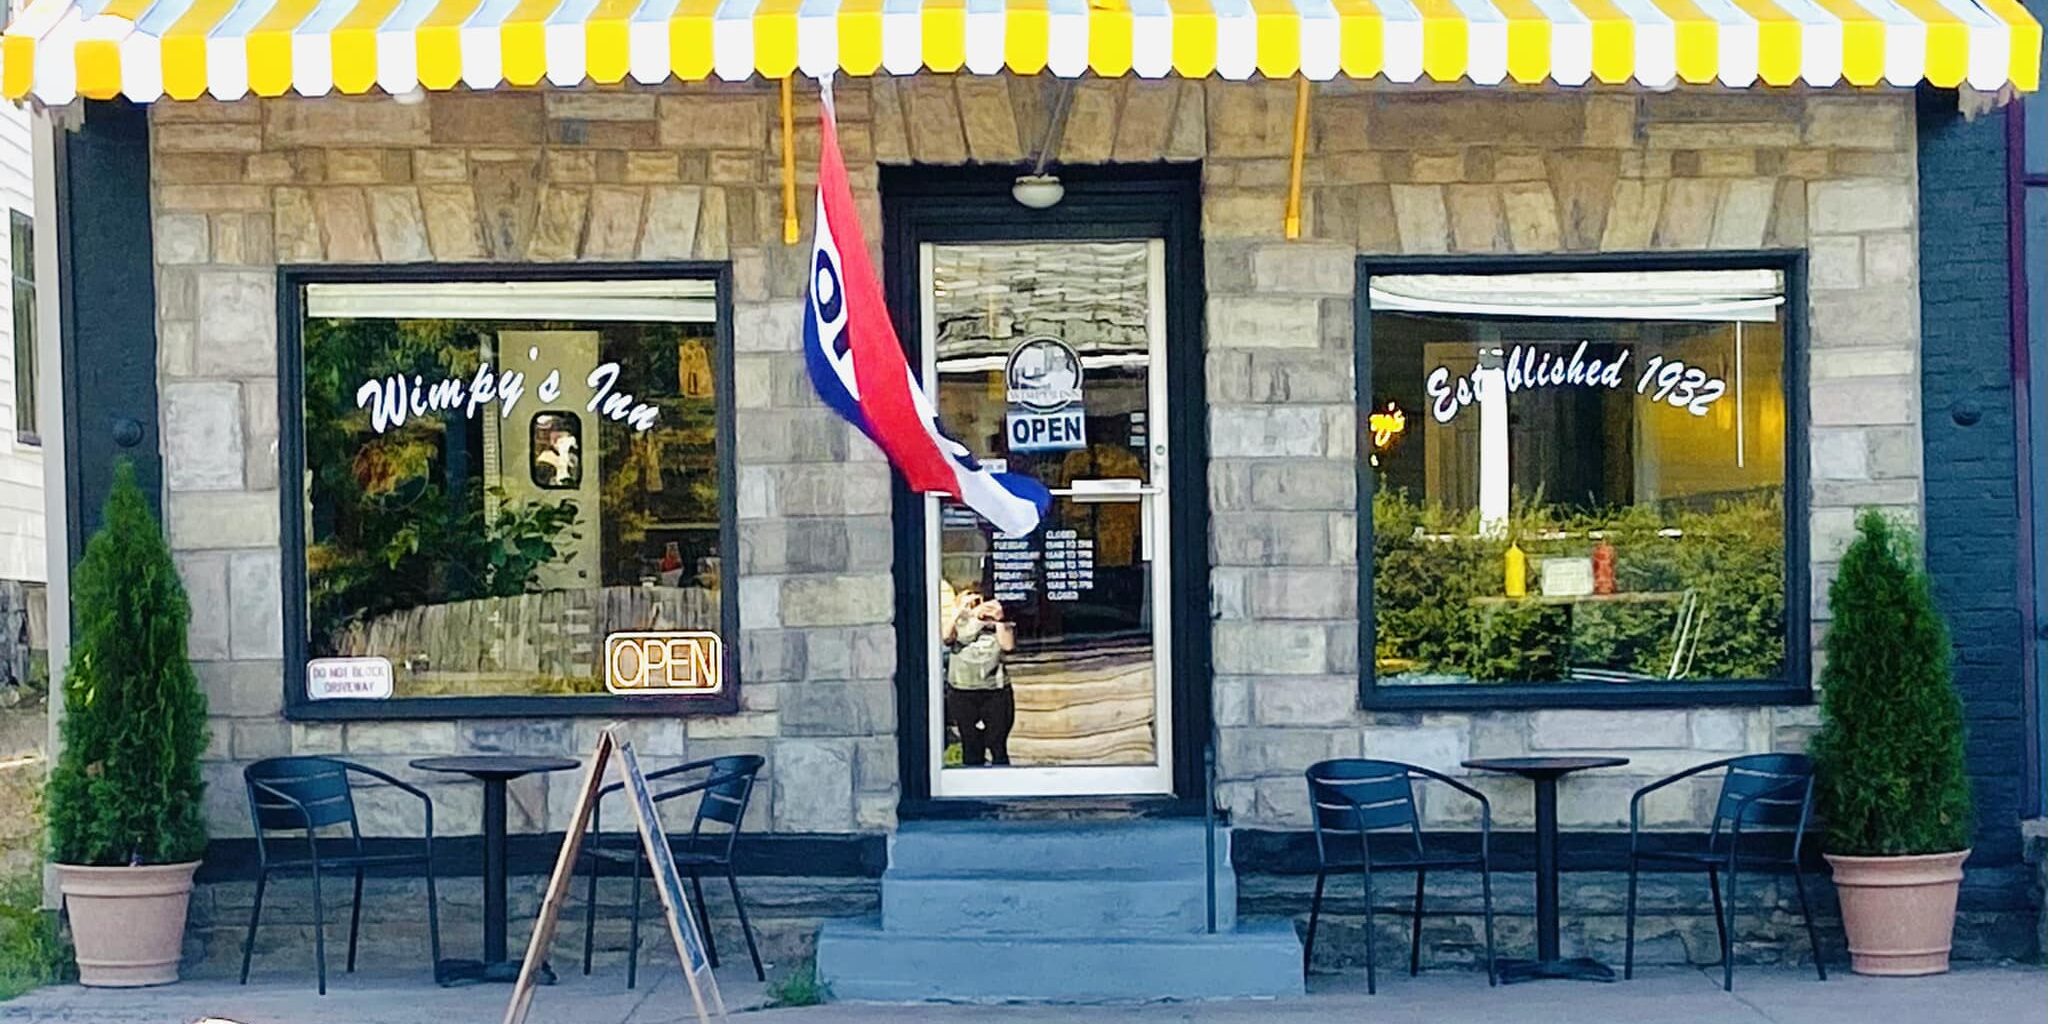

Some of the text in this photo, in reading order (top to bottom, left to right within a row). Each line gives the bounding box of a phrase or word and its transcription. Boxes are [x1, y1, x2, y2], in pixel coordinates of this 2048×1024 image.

[357, 346, 660, 434] Wimpy's Inn
[1637, 356, 1726, 416] 1932
[1013, 417, 1081, 444] OPEN
[313, 666, 384, 678] DO NOT BLOCK
[612, 639, 716, 687] OPEN
[324, 681, 375, 693] DRIVEWAY
